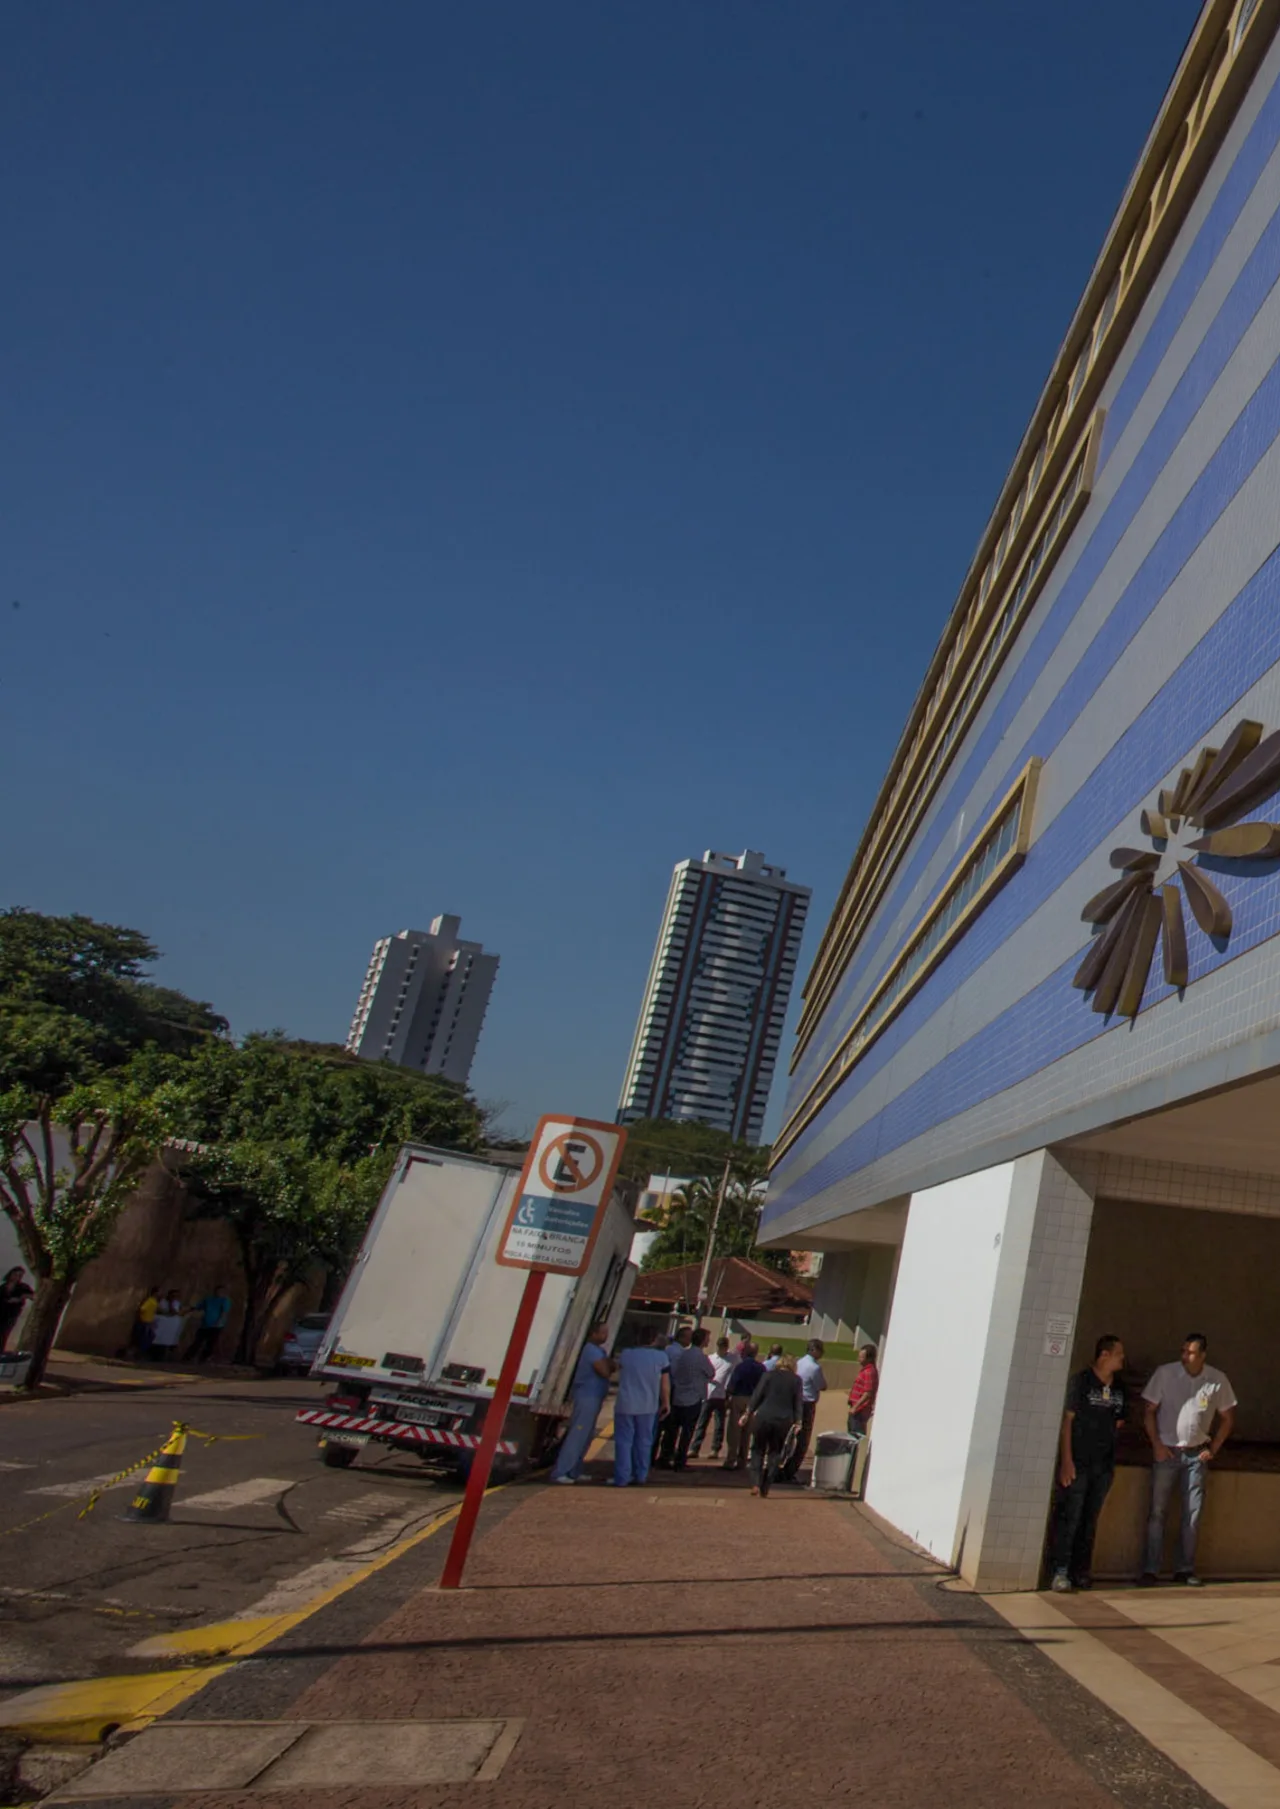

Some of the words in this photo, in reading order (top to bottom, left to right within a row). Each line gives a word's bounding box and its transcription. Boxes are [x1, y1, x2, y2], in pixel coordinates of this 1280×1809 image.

[549, 1232, 586, 1245] BRANCA
[527, 1242, 572, 1254] MINUTOS
[396, 1394, 449, 1408] FACCHINI
